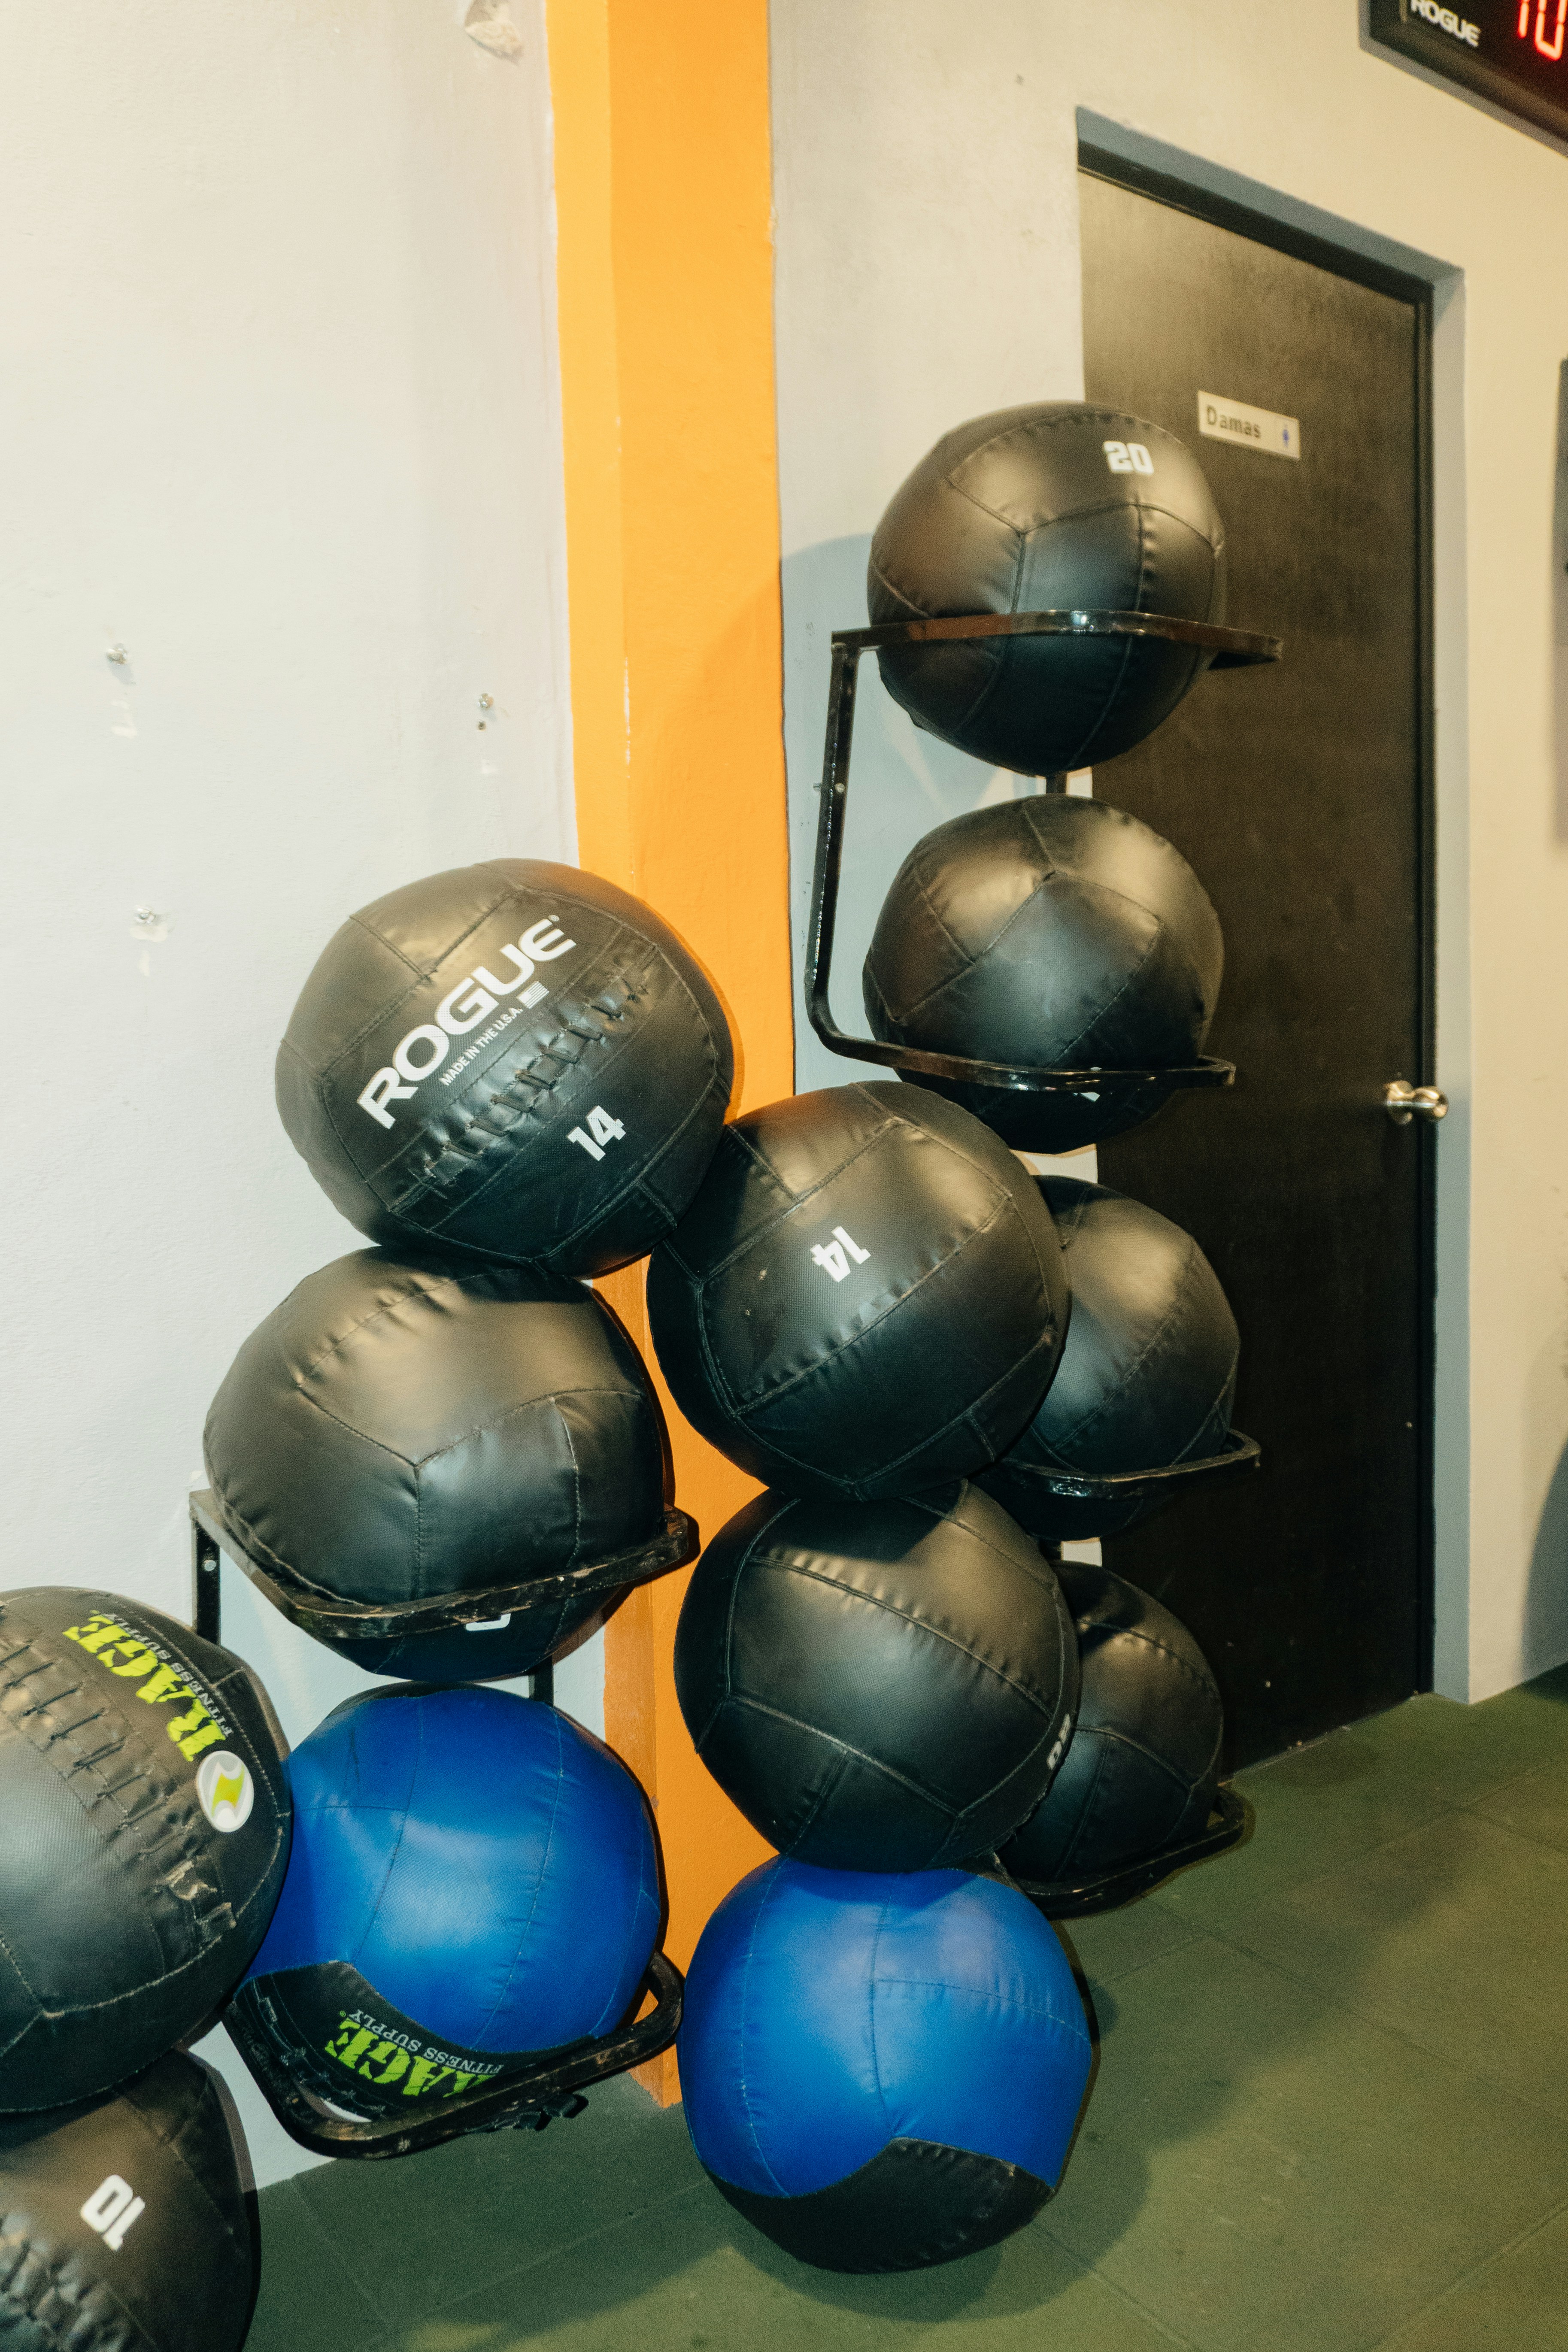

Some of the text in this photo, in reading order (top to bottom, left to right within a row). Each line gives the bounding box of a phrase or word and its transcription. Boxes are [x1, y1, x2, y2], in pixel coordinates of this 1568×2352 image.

[1411, 0, 1481, 47] ROGUE
[1206, 404, 1262, 439] Damas
[1102, 440, 1155, 476] 20
[357, 918, 576, 1130] ROGUE
[439, 1007, 523, 1086] MADE IN THE U.S.A.
[566, 1105, 626, 1161] 14
[810, 1226, 871, 1282] 14
[63, 1615, 226, 1761] RAGE
[104, 1613, 233, 1737] FITNESS SUPPLY
[349, 2009, 504, 2074] FITNESS SUPPLY
[80, 2174, 146, 2251] 10
